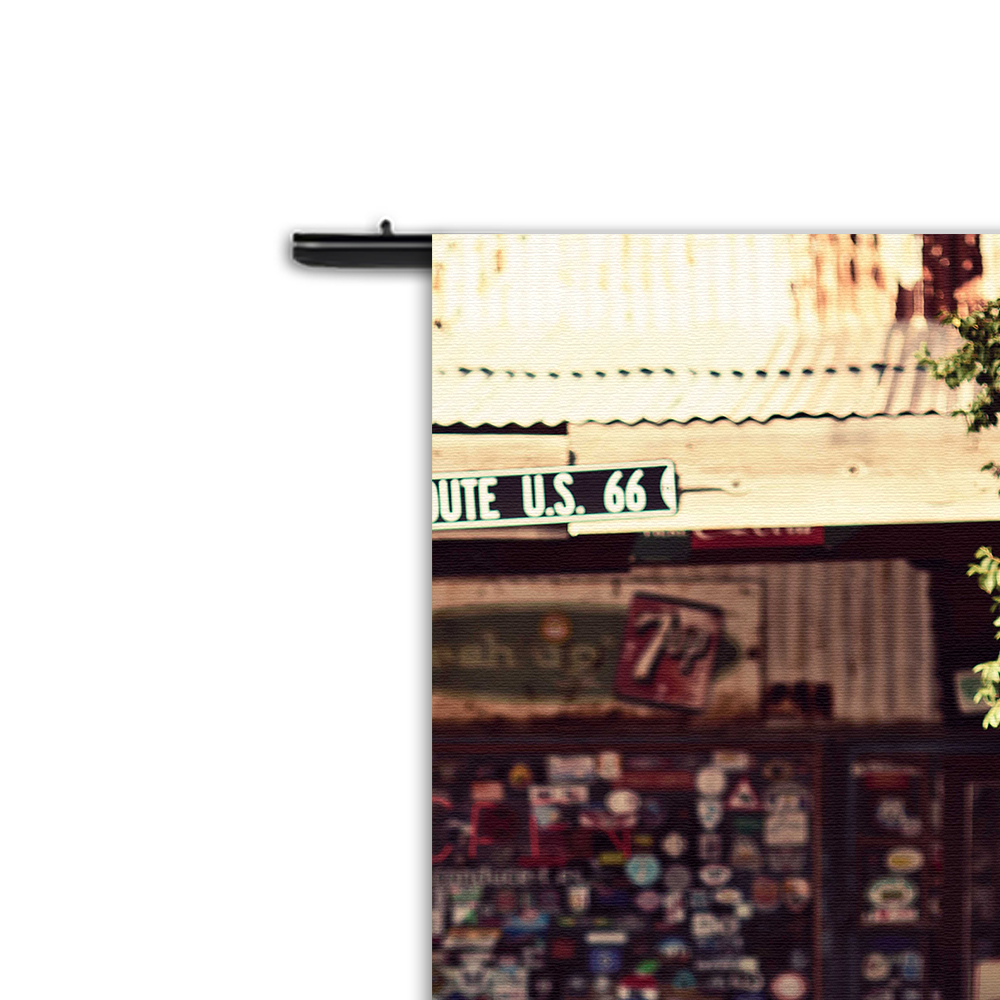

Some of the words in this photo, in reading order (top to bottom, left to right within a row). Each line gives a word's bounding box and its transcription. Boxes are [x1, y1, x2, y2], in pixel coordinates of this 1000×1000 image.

[432, 478, 501, 523] UTE
[521, 472, 586, 518] U.S.
[603, 468, 647, 513] 66
